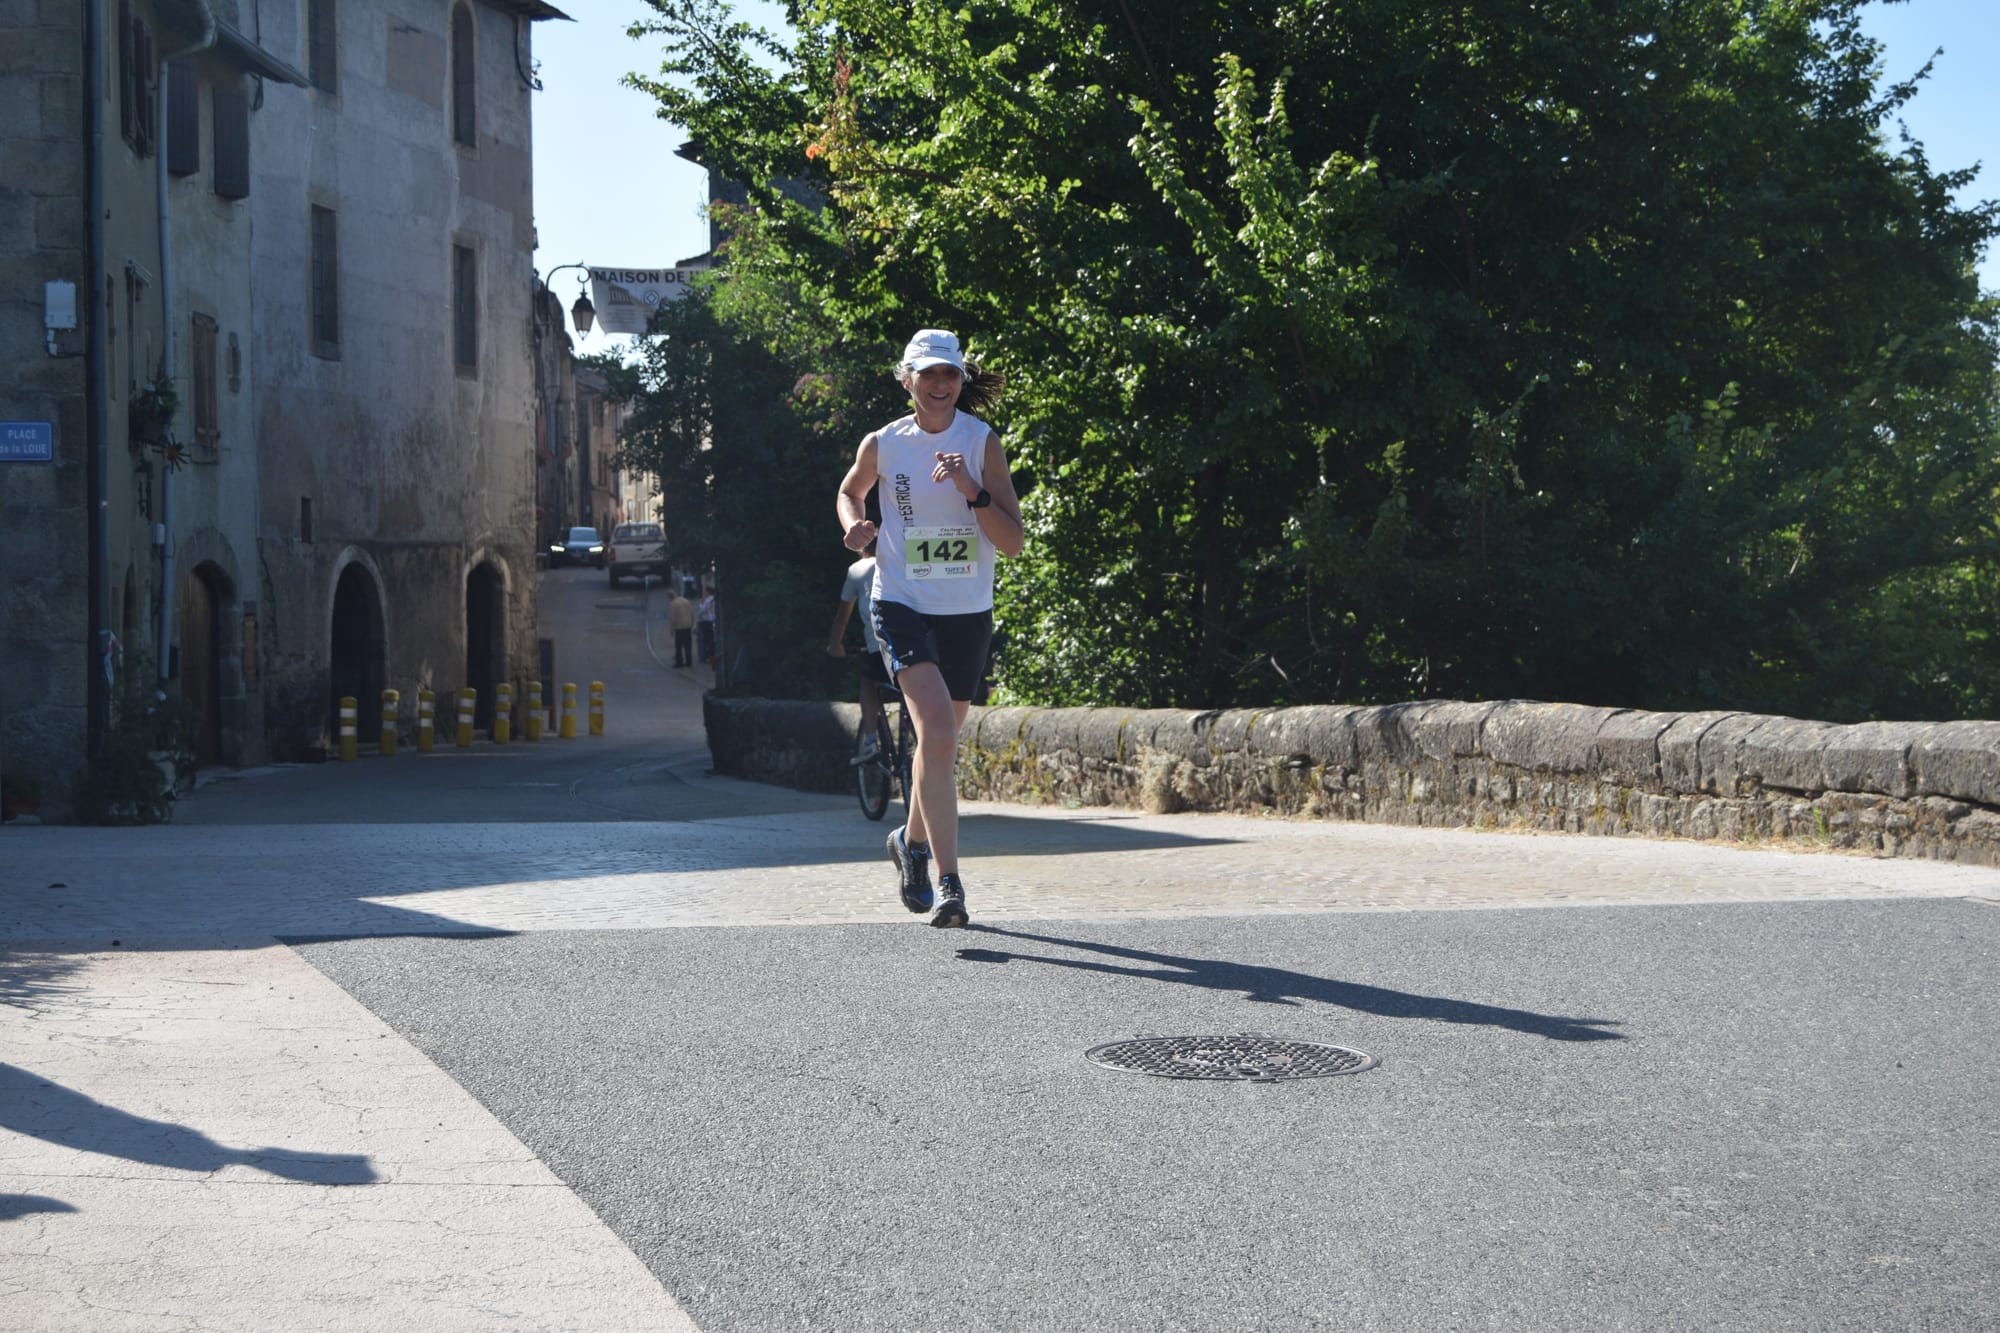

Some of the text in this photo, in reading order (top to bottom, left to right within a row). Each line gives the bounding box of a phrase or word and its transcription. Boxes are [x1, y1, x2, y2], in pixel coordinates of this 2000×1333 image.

[594, 271, 659, 283] MAISON
[664, 271, 685, 283] DE
[8, 429, 37, 440] PLACE
[23, 444, 48, 454] LOUE
[917, 540, 968, 562] 142
